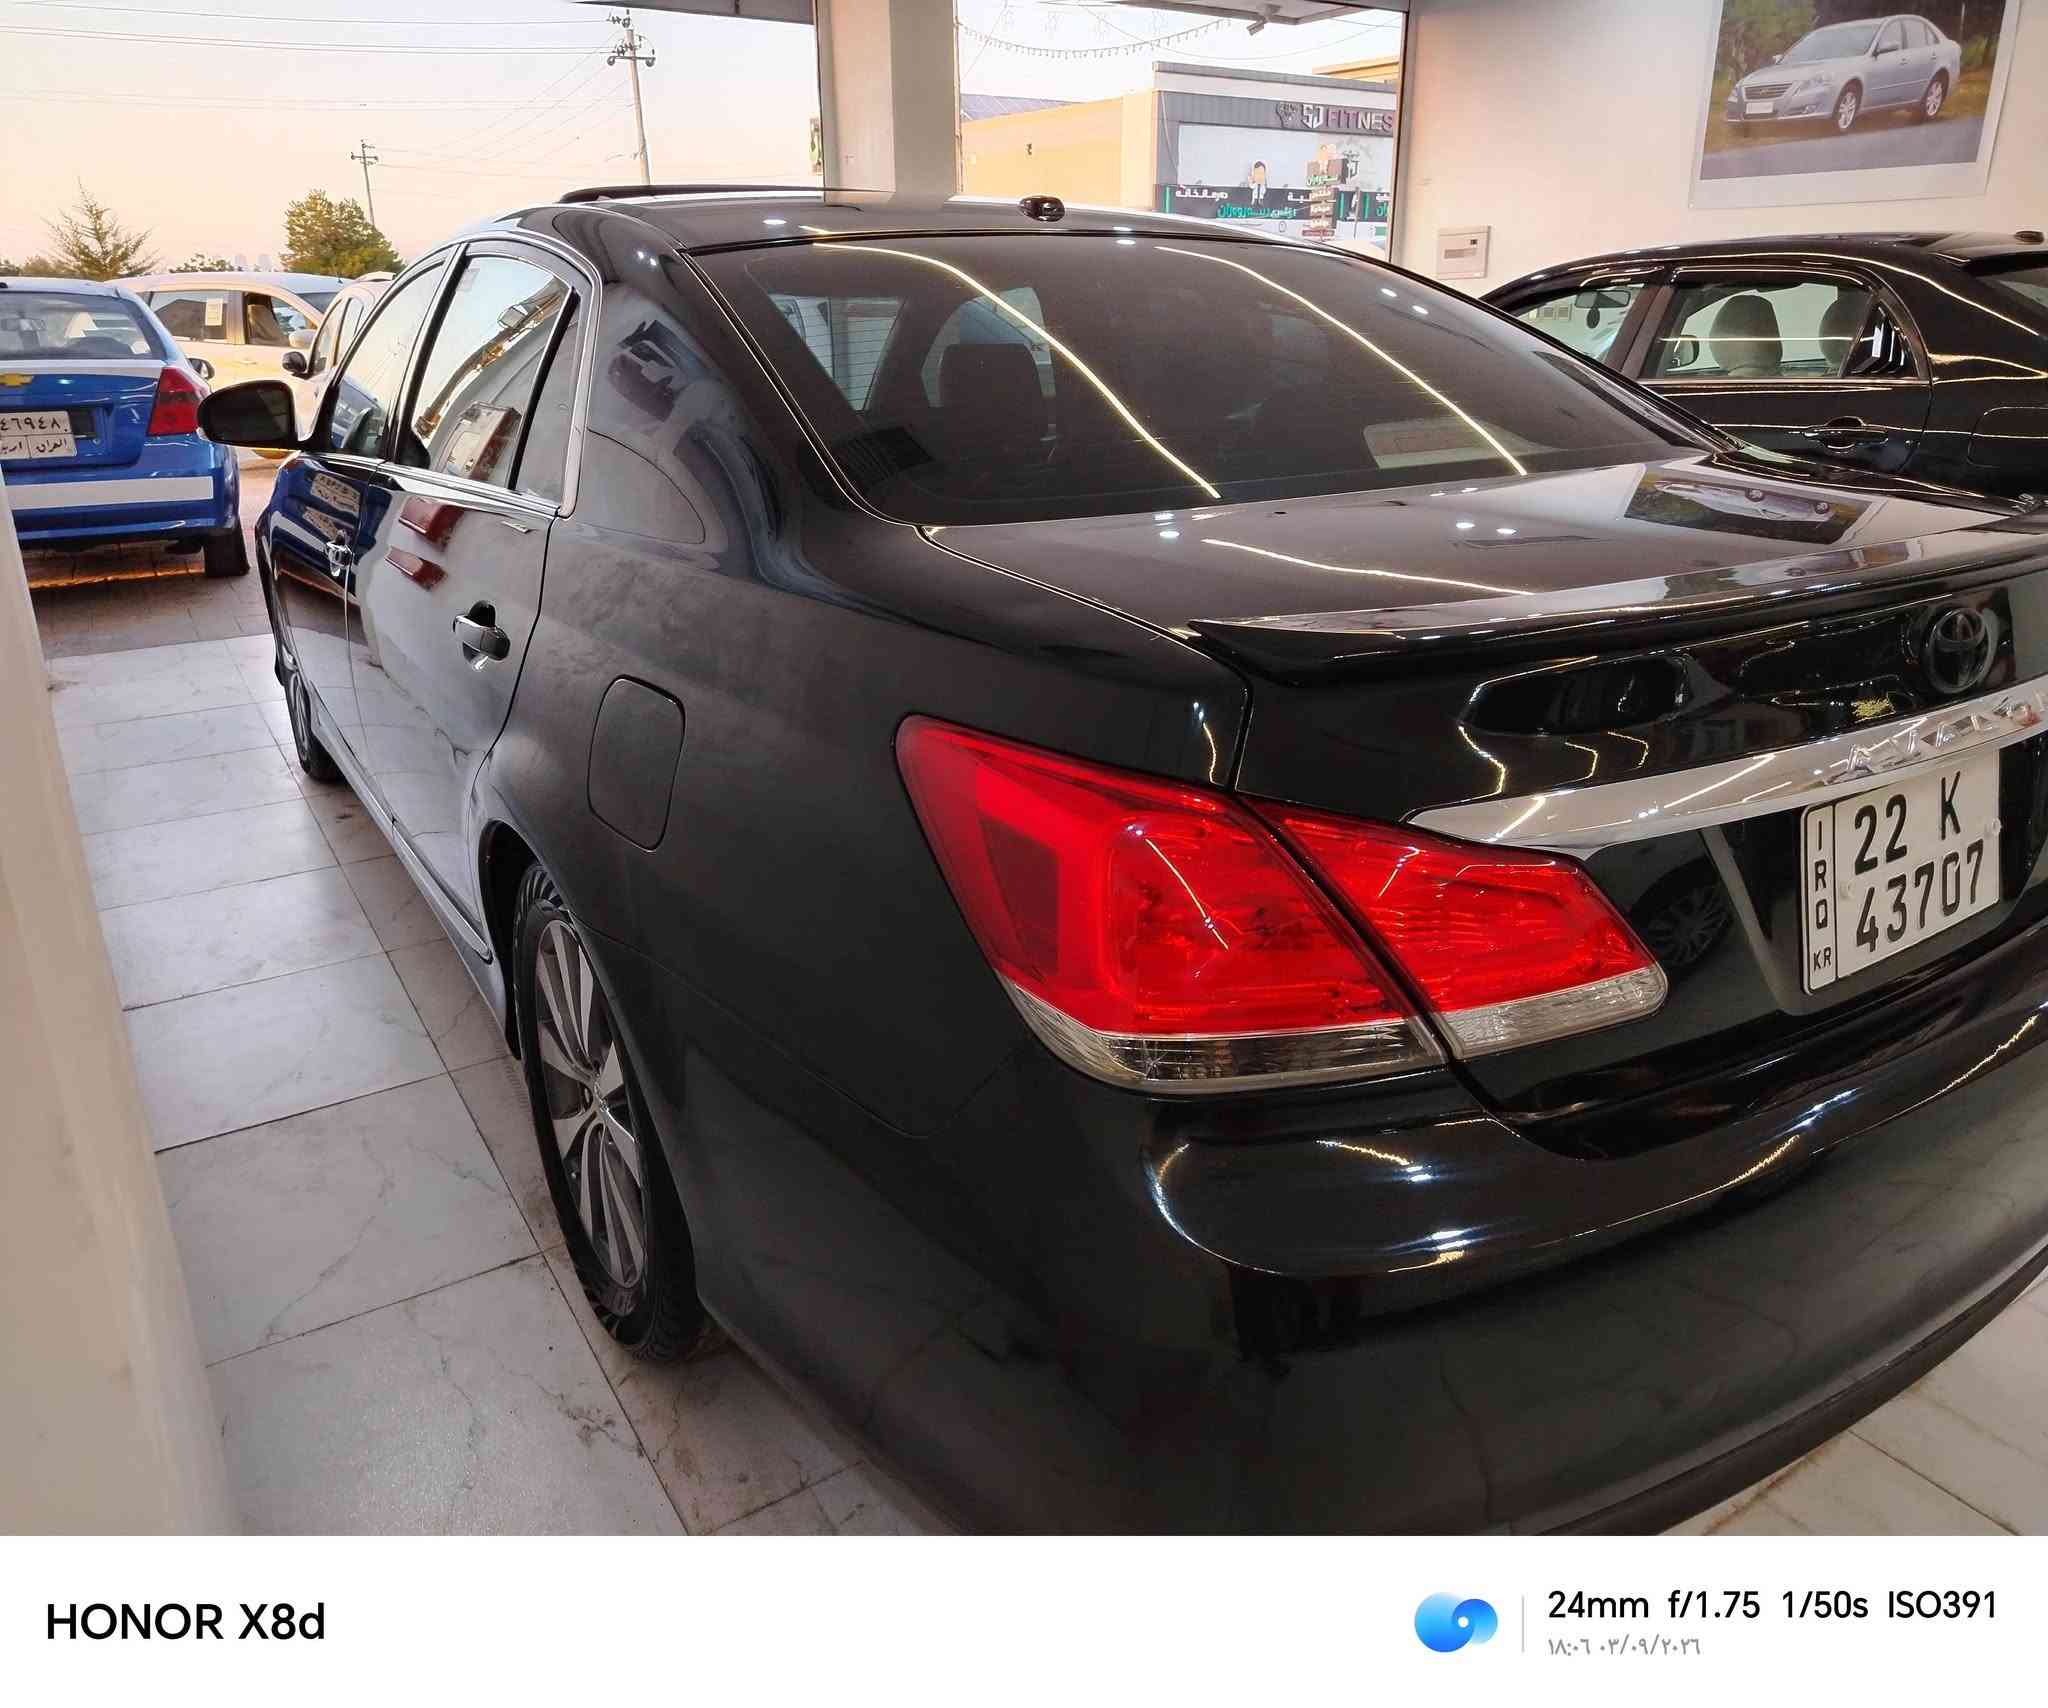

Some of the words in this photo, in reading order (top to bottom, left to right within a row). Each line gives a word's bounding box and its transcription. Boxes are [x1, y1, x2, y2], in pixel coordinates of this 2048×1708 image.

[1813, 820, 1829, 930] IRQ
[1854, 794, 1908, 875] 22
[1940, 770, 1961, 841] K
[1855, 838, 1984, 953] 43707
[1812, 946, 1832, 972] KR
